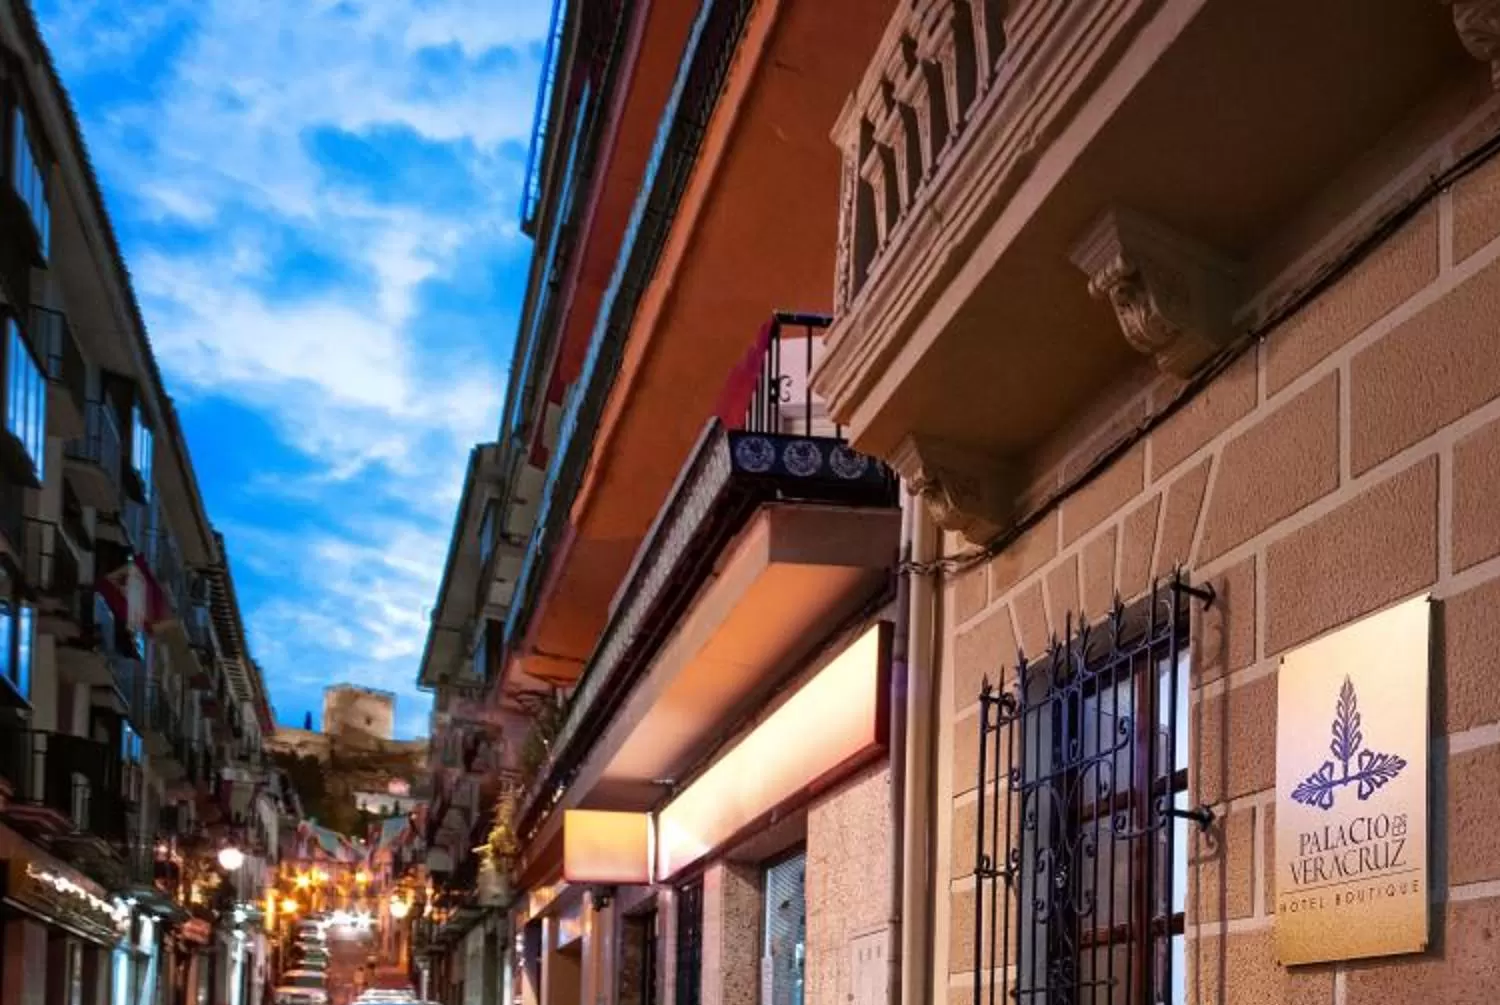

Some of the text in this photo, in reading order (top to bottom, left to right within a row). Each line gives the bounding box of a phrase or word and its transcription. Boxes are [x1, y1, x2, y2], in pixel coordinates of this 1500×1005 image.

[1299, 813, 1389, 857] PALACIO
[1289, 837, 1407, 885] VERACRUZ
[1279, 879, 1420, 913] HOTEL BOUTIQUE
